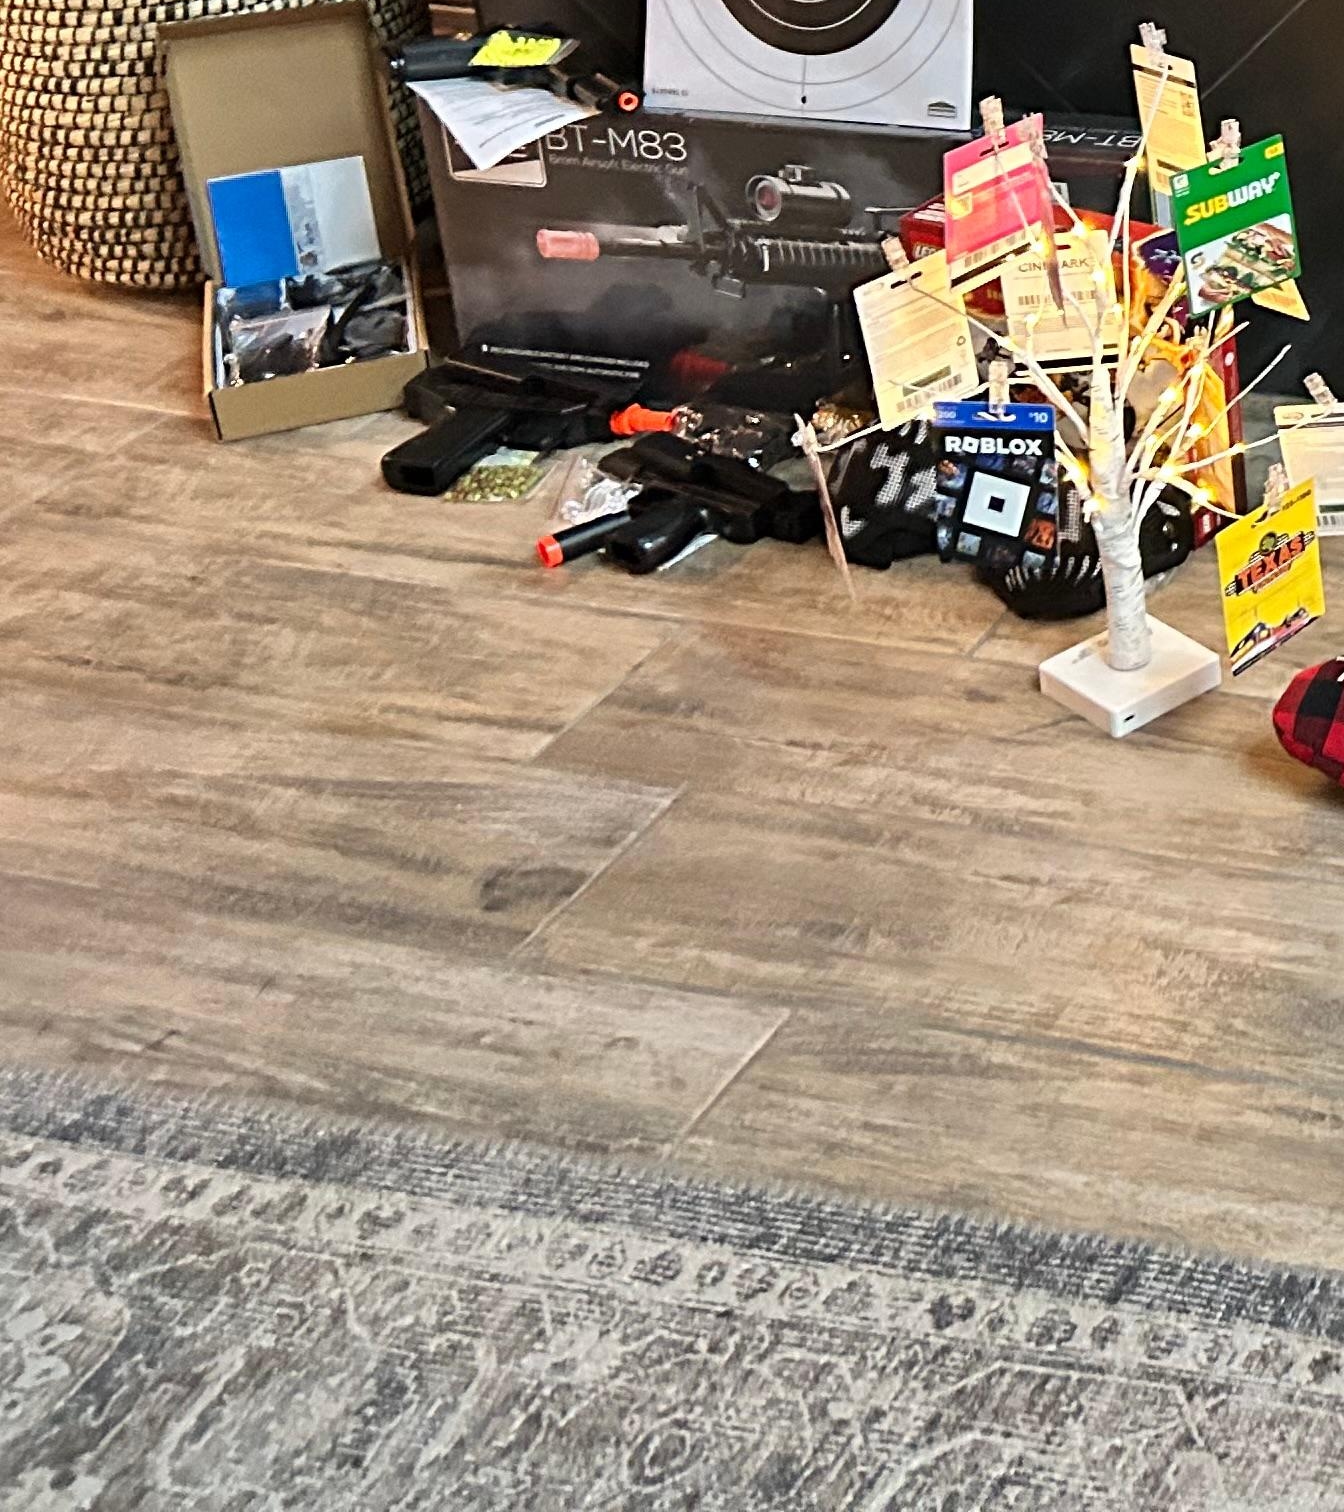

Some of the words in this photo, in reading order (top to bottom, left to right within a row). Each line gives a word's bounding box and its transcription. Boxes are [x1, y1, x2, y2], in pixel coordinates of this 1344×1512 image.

[545, 124, 688, 161] BT-M83
[1042, 129, 1142, 148] BT-M8
[1184, 171, 1281, 226] SUBWAY
[1018, 258, 1089, 273] CINARK
[944, 435, 1043, 456] ROBLOX
[1236, 533, 1306, 591] TEXAS
